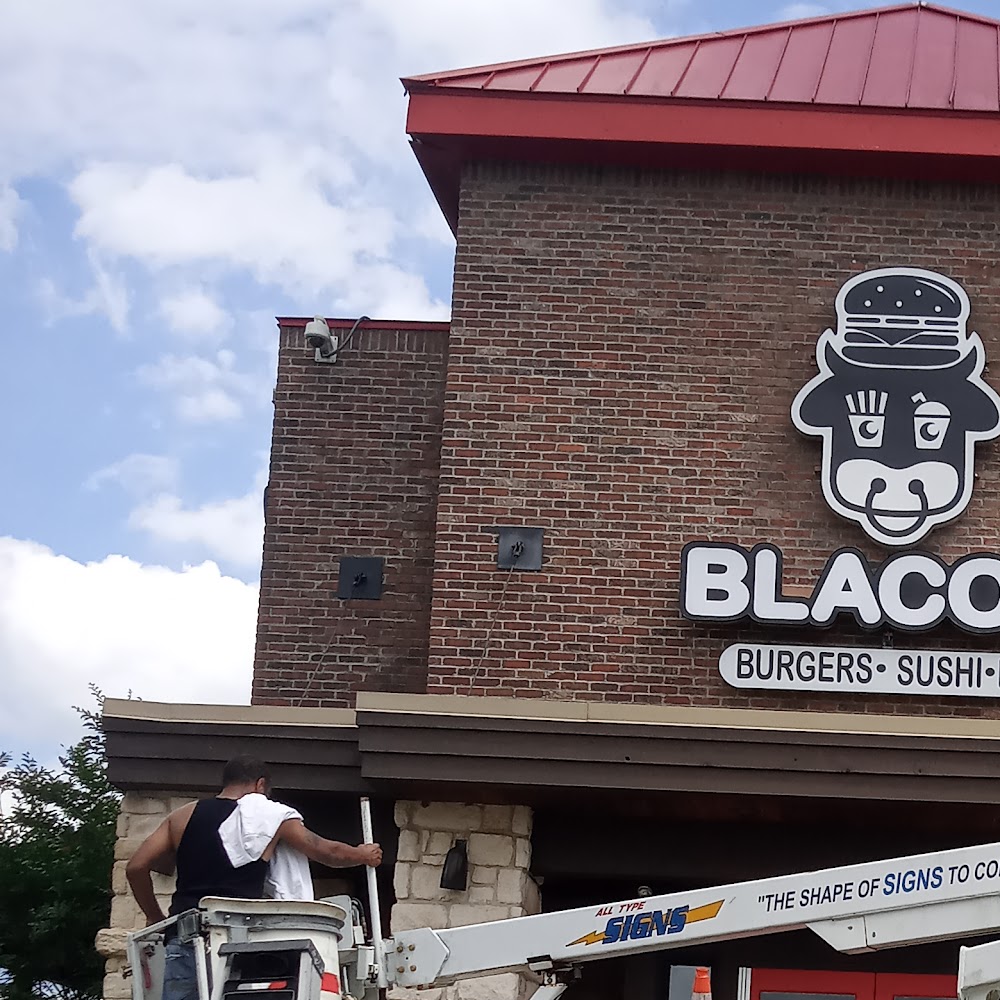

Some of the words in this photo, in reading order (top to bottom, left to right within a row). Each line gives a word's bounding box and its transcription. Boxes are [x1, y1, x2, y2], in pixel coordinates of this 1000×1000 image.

[799, 882, 854, 907] SHAPE
[857, 878, 881, 898] OF
[882, 866, 944, 895] SIGNS
[948, 864, 970, 885] TO
[595, 906, 613, 917] ALL
[618, 901, 647, 914] TYPE
[601, 904, 690, 945] SIGNS
